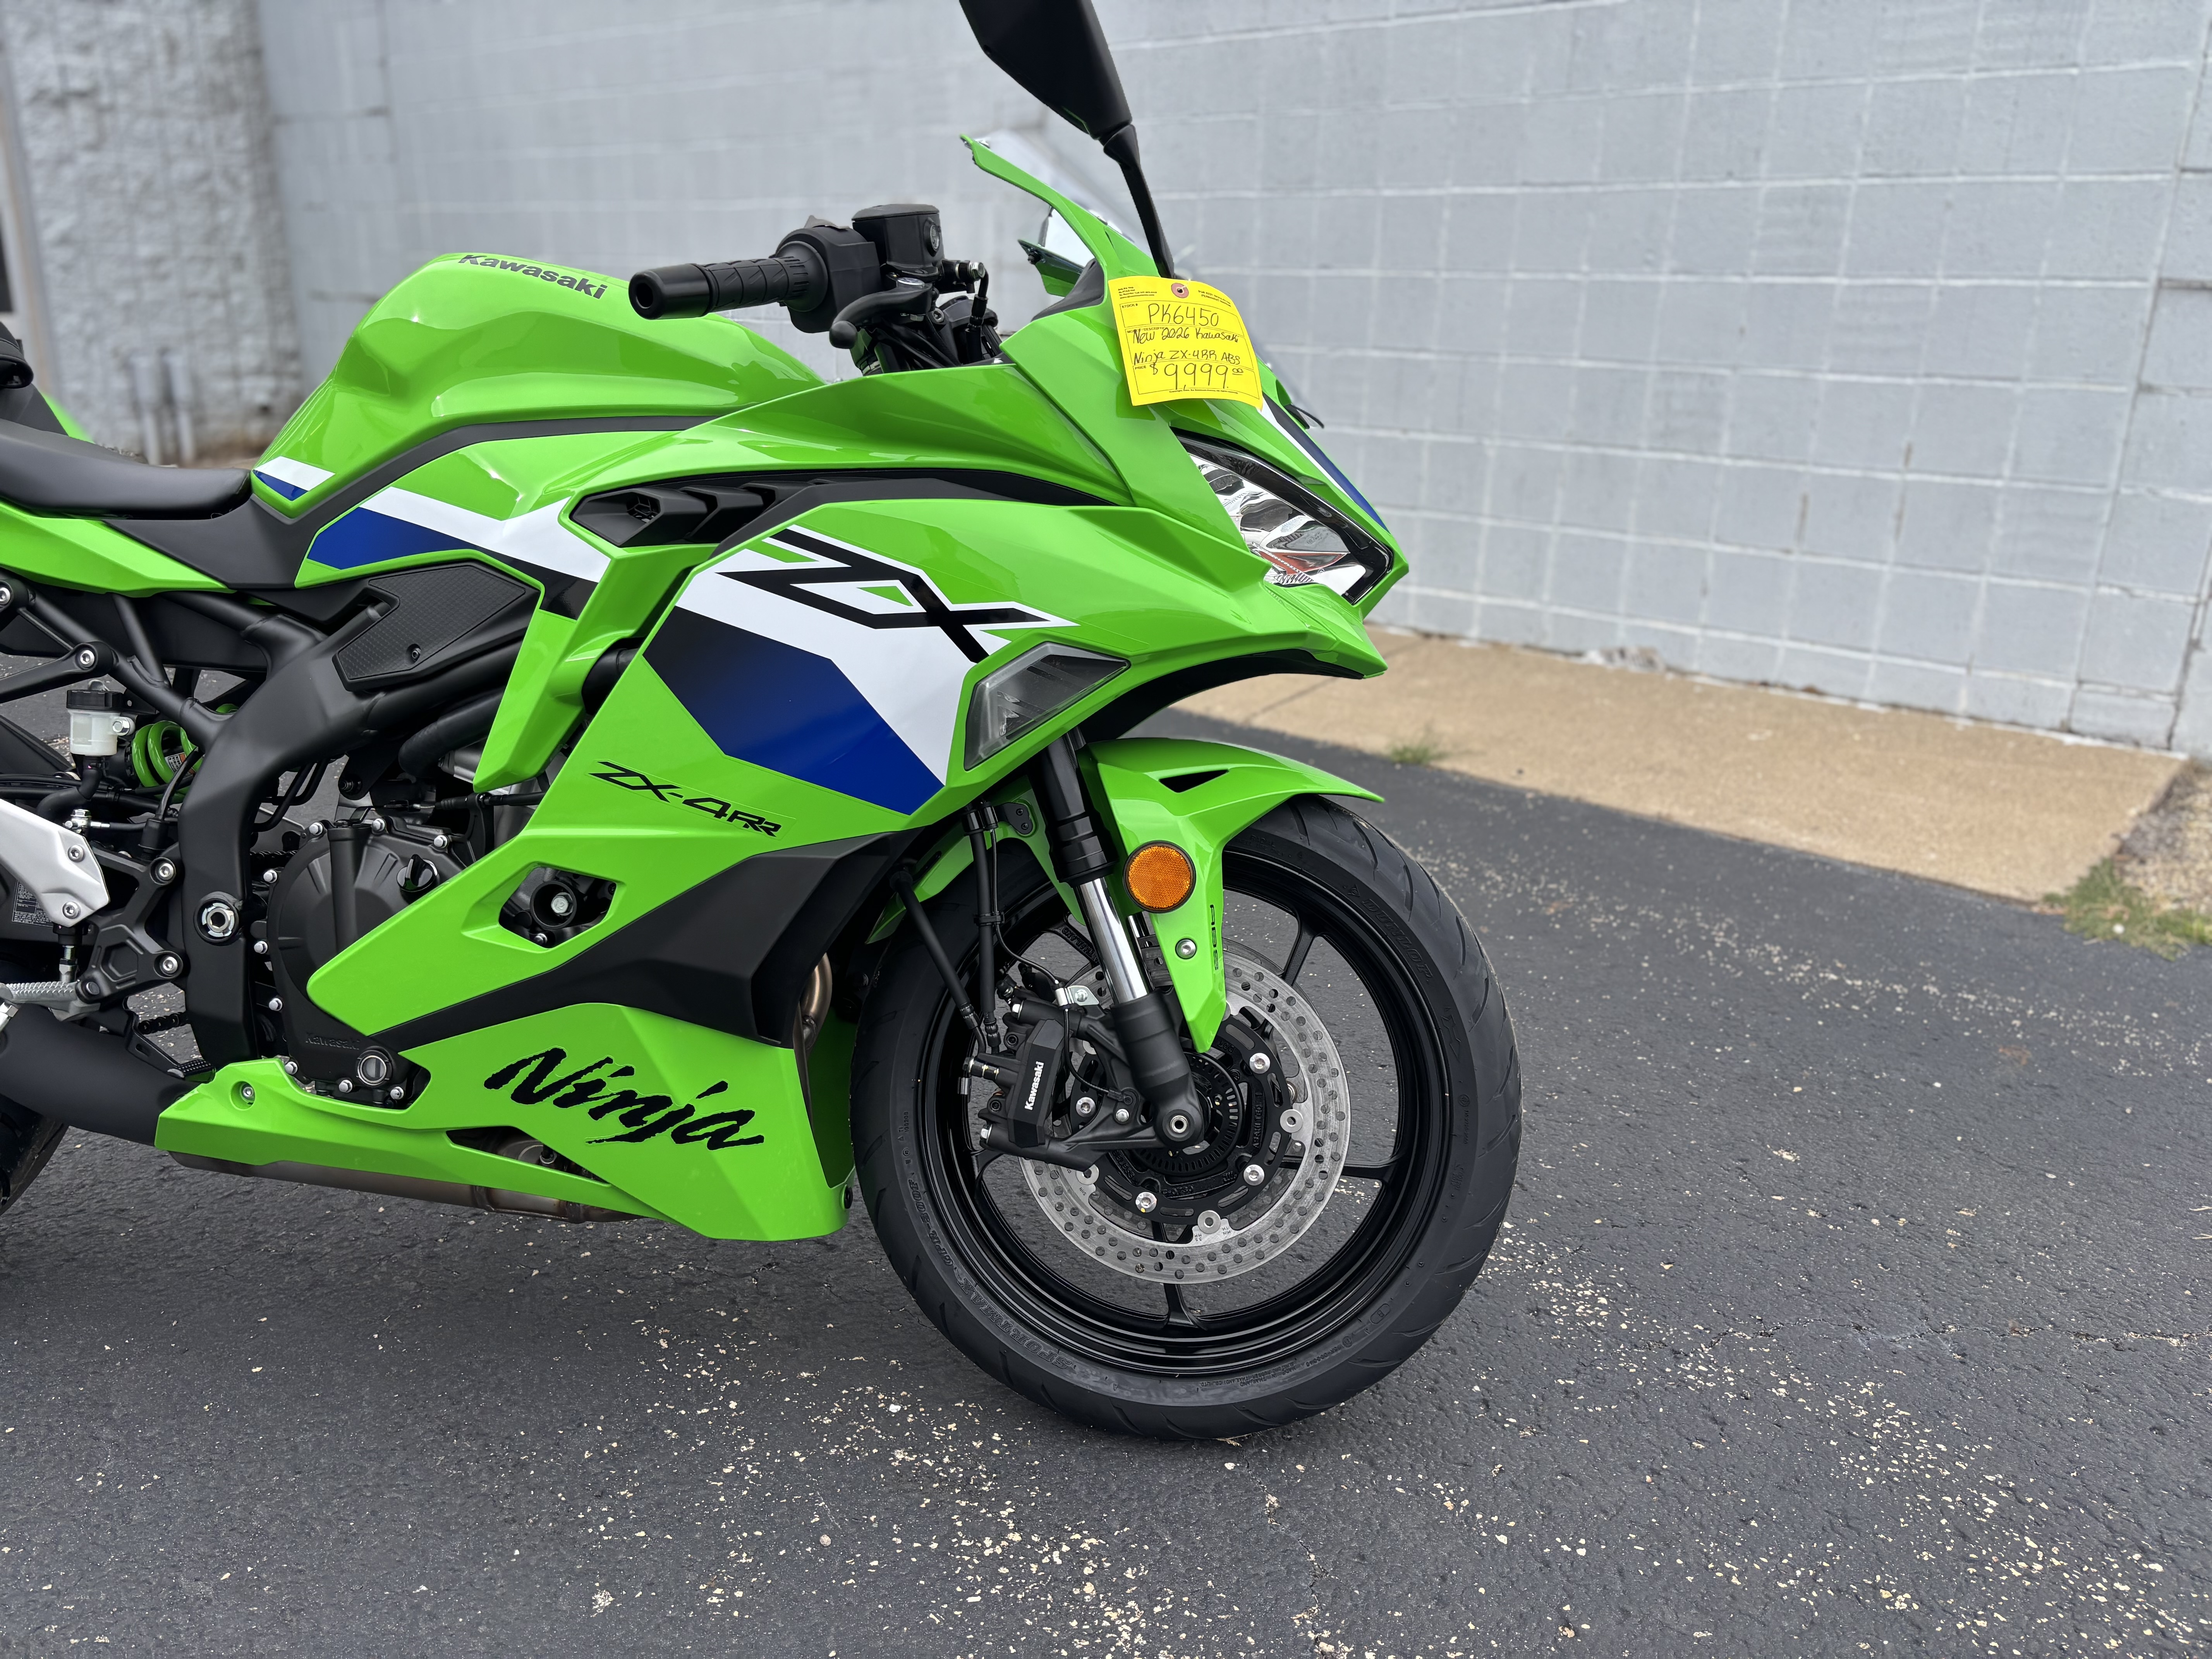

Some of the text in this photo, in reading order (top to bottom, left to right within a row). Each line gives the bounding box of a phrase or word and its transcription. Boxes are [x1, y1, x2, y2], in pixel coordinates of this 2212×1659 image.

[458, 255, 608, 299] Kawasaki
[1133, 327, 1238, 344] New 2026 Kawasaki
[1148, 303, 1219, 326] PK6450
[1134, 349, 1166, 366] Ninja
[1221, 352, 1240, 365] ABS
[715, 528, 1051, 664] ZX
[587, 761, 782, 837] ZX-4RR
[1209, 904, 1218, 970] ABS
[1361, 898, 1434, 979] DUNLOP
[1216, 1040, 1235, 1053] DOT
[484, 1047, 765, 1151] Ninja
[1024, 1061, 1044, 1111] Kawasaki
[957, 1278, 1074, 1369] SPORTMAX
